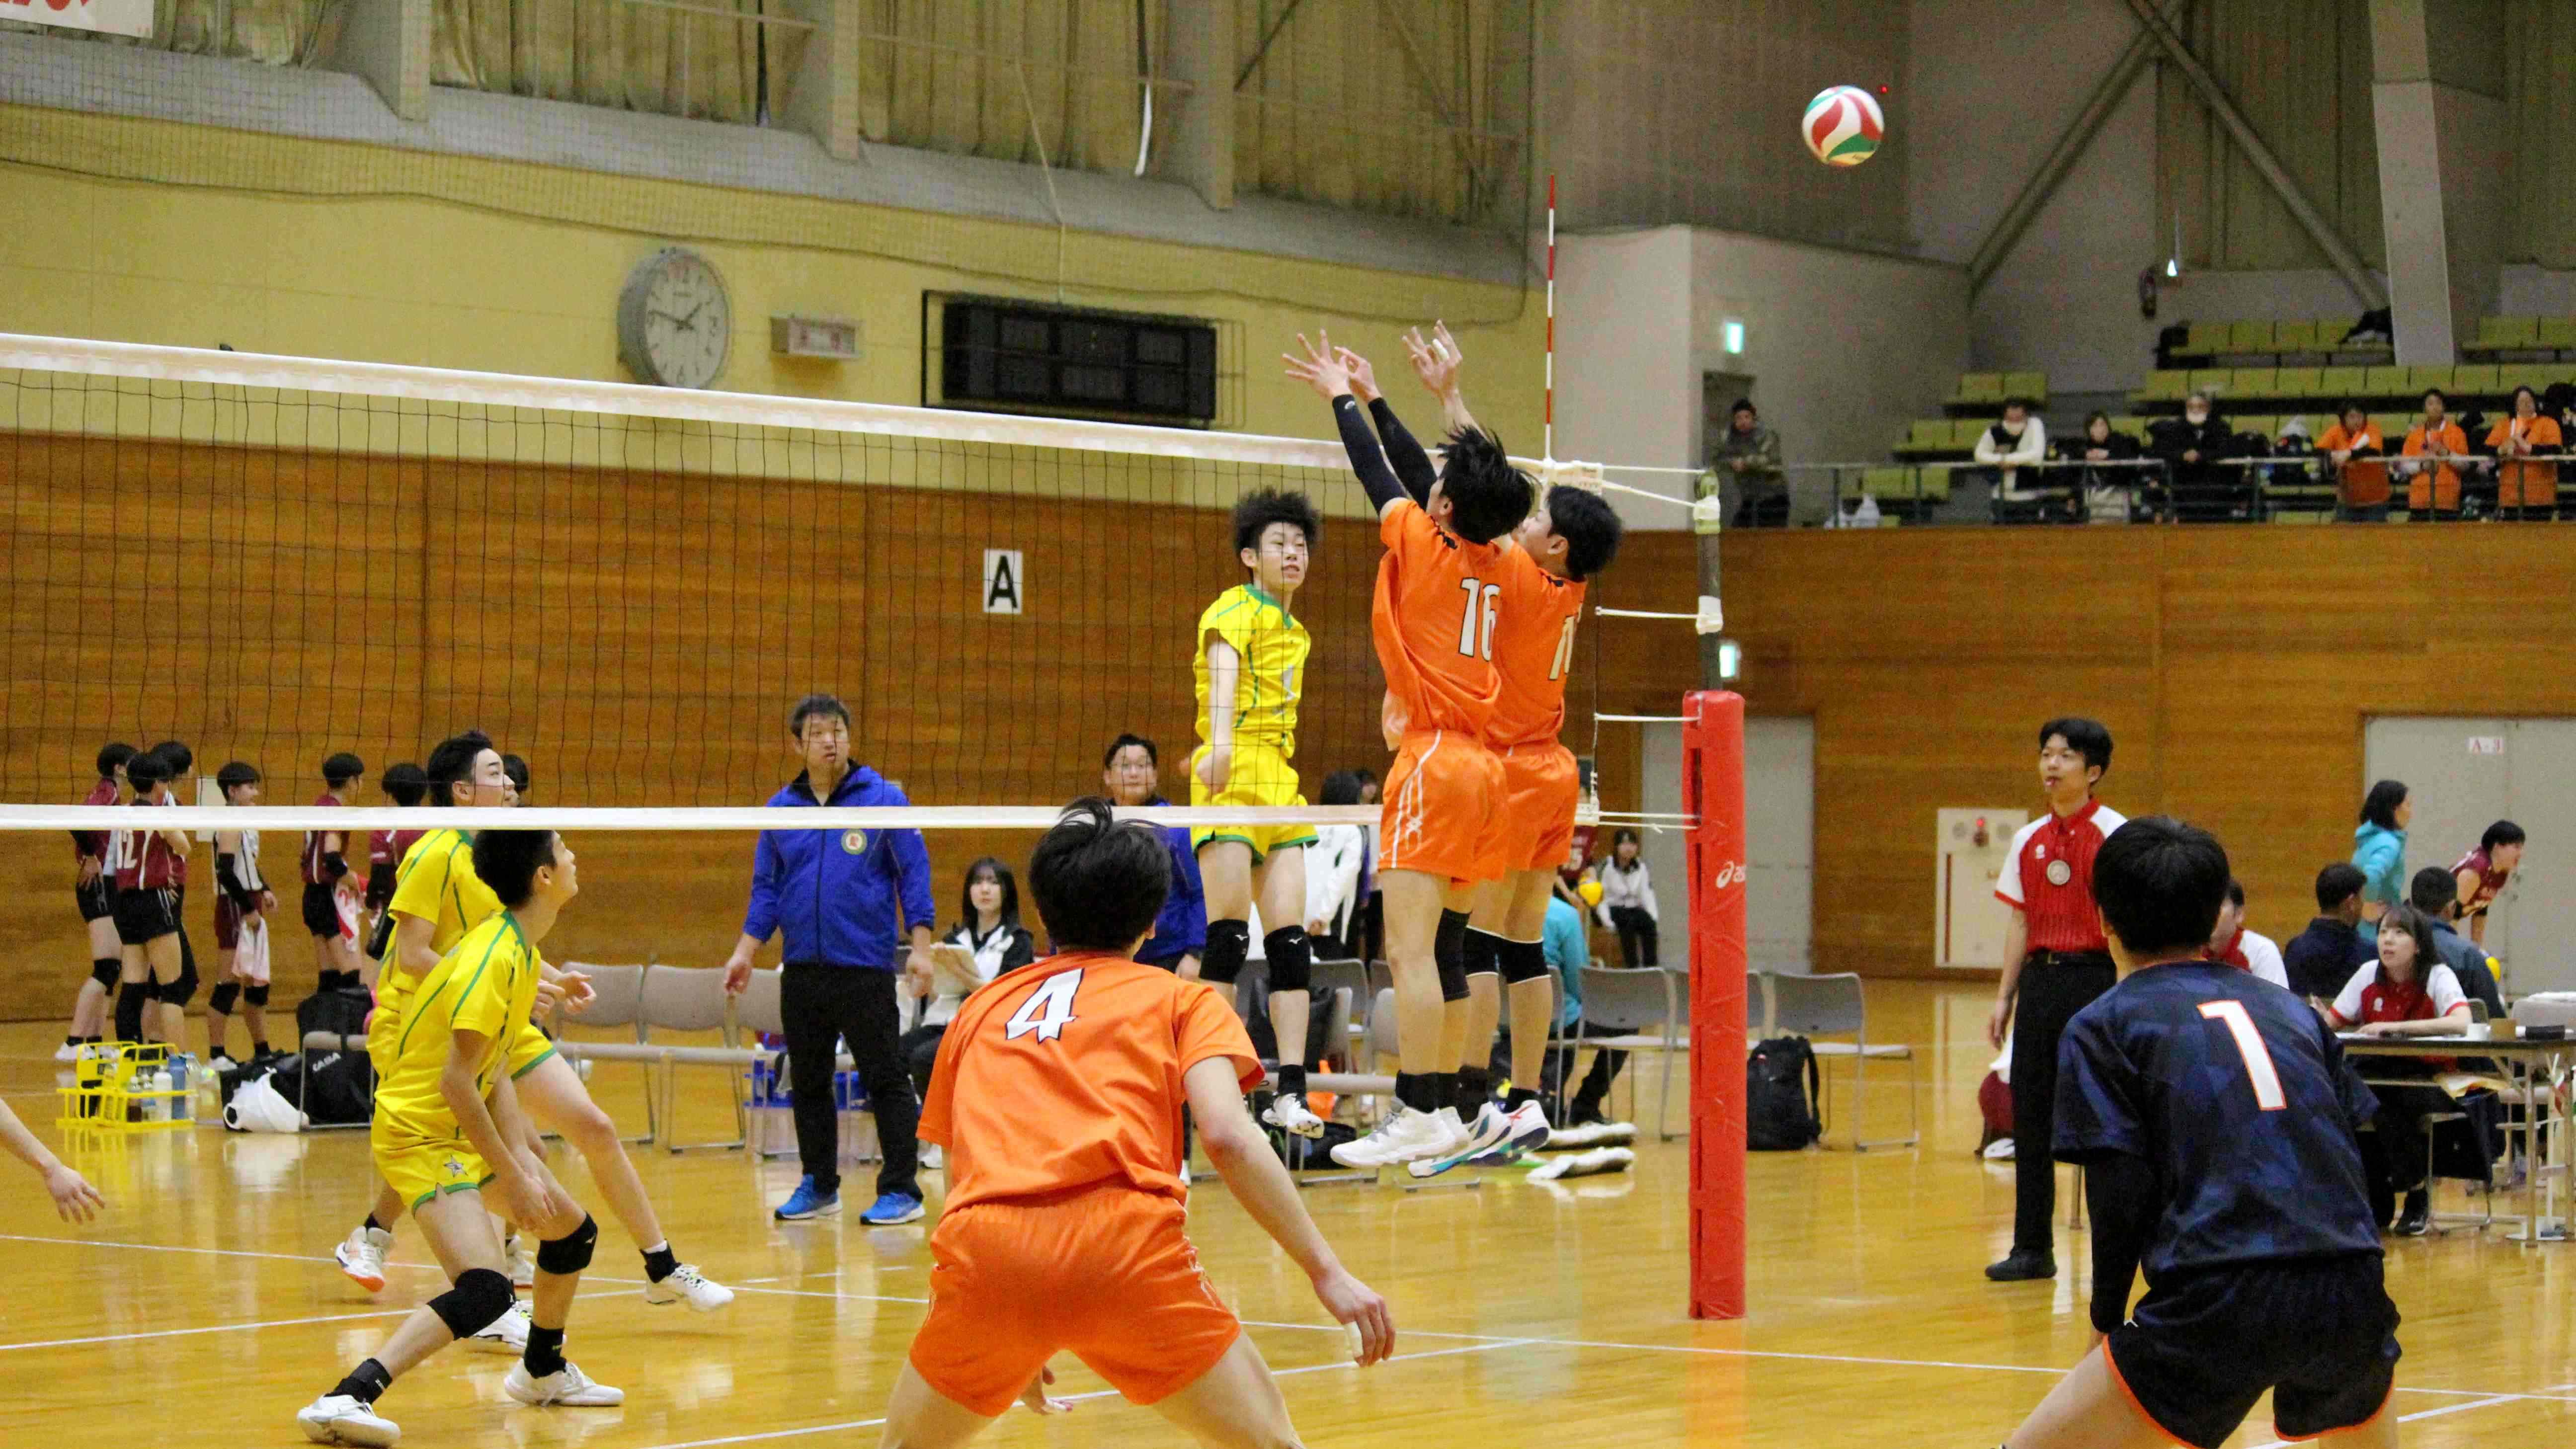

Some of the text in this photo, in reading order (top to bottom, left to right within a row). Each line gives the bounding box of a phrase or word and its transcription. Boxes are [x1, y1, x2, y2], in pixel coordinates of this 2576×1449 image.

[988, 555, 1018, 608] A
[1458, 577, 1501, 662] 16
[1005, 967, 1085, 1045] 4
[2196, 999, 2288, 1111] 1
